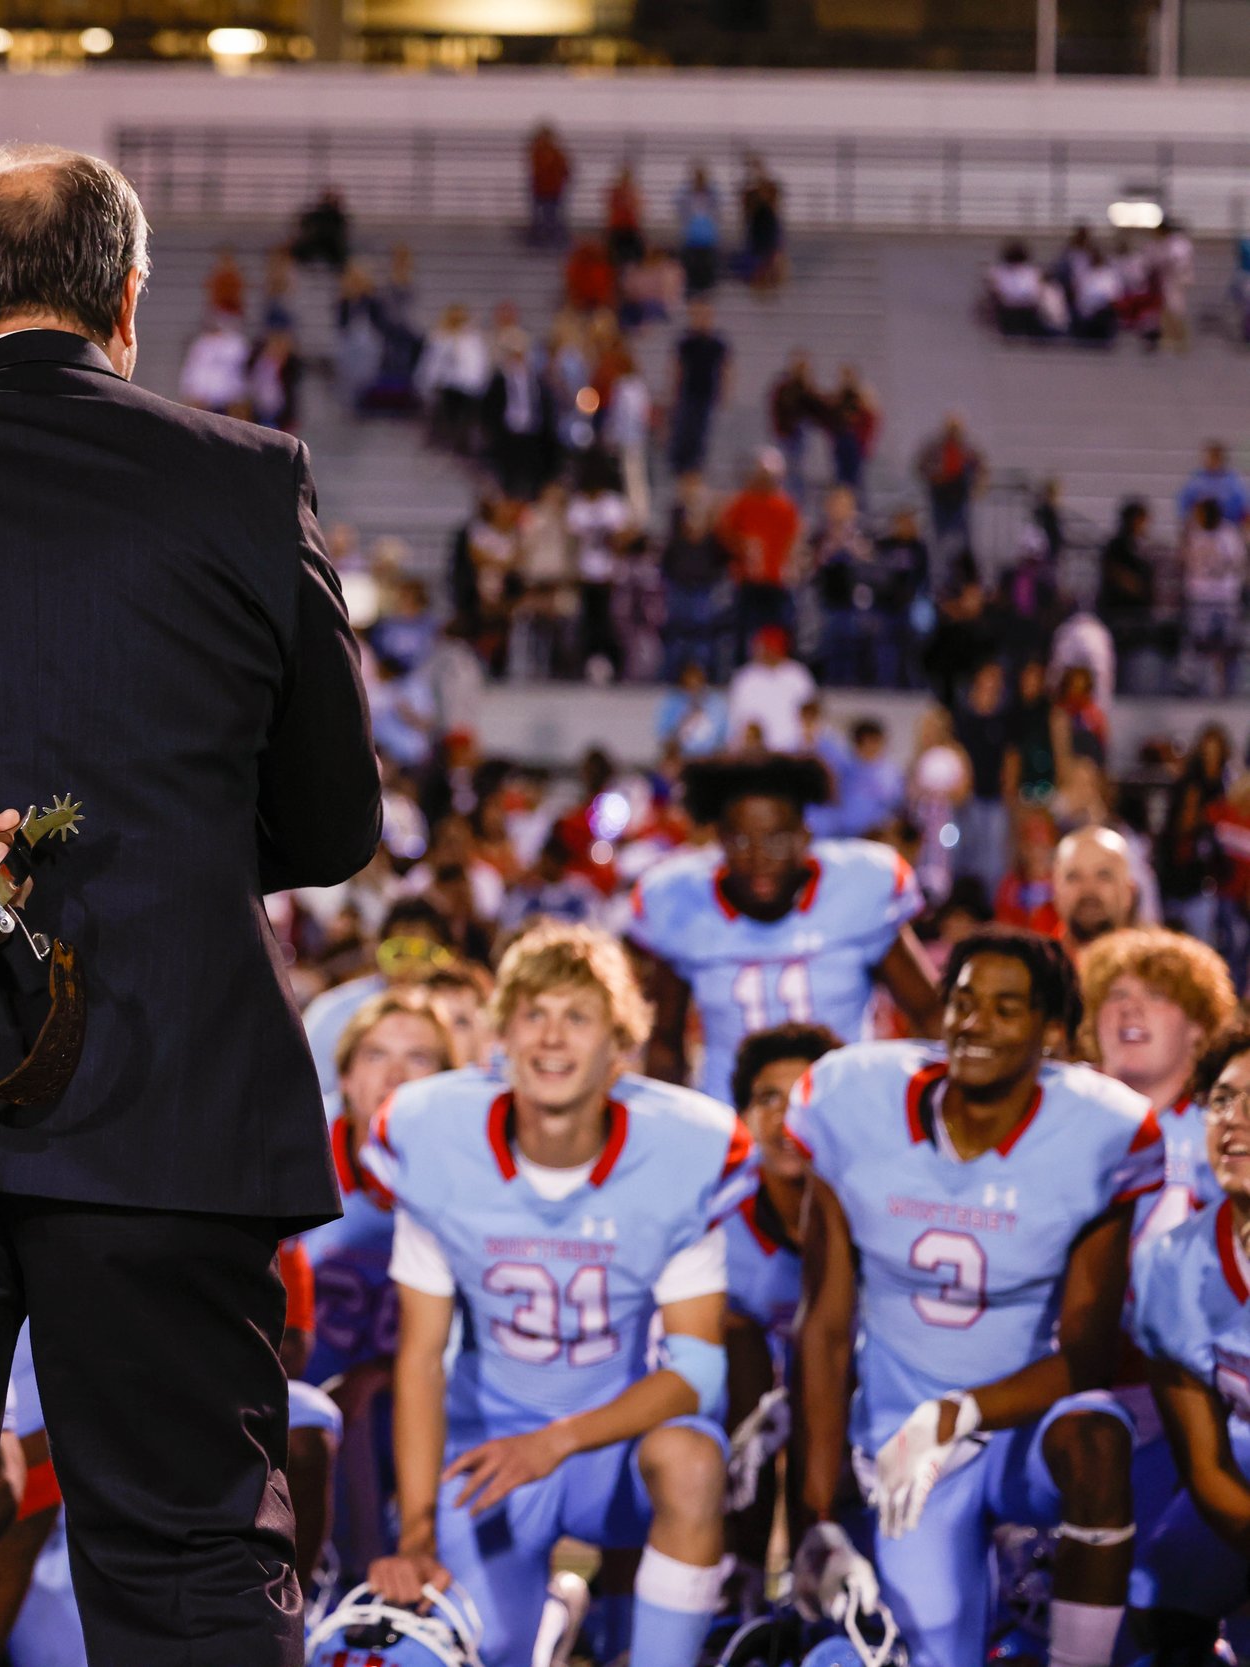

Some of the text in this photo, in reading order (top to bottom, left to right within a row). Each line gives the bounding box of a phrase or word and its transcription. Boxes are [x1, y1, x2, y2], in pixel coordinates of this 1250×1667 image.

[729, 957, 813, 1032] 11
[481, 1260, 622, 1369] 31
[909, 1226, 989, 1332] 3
